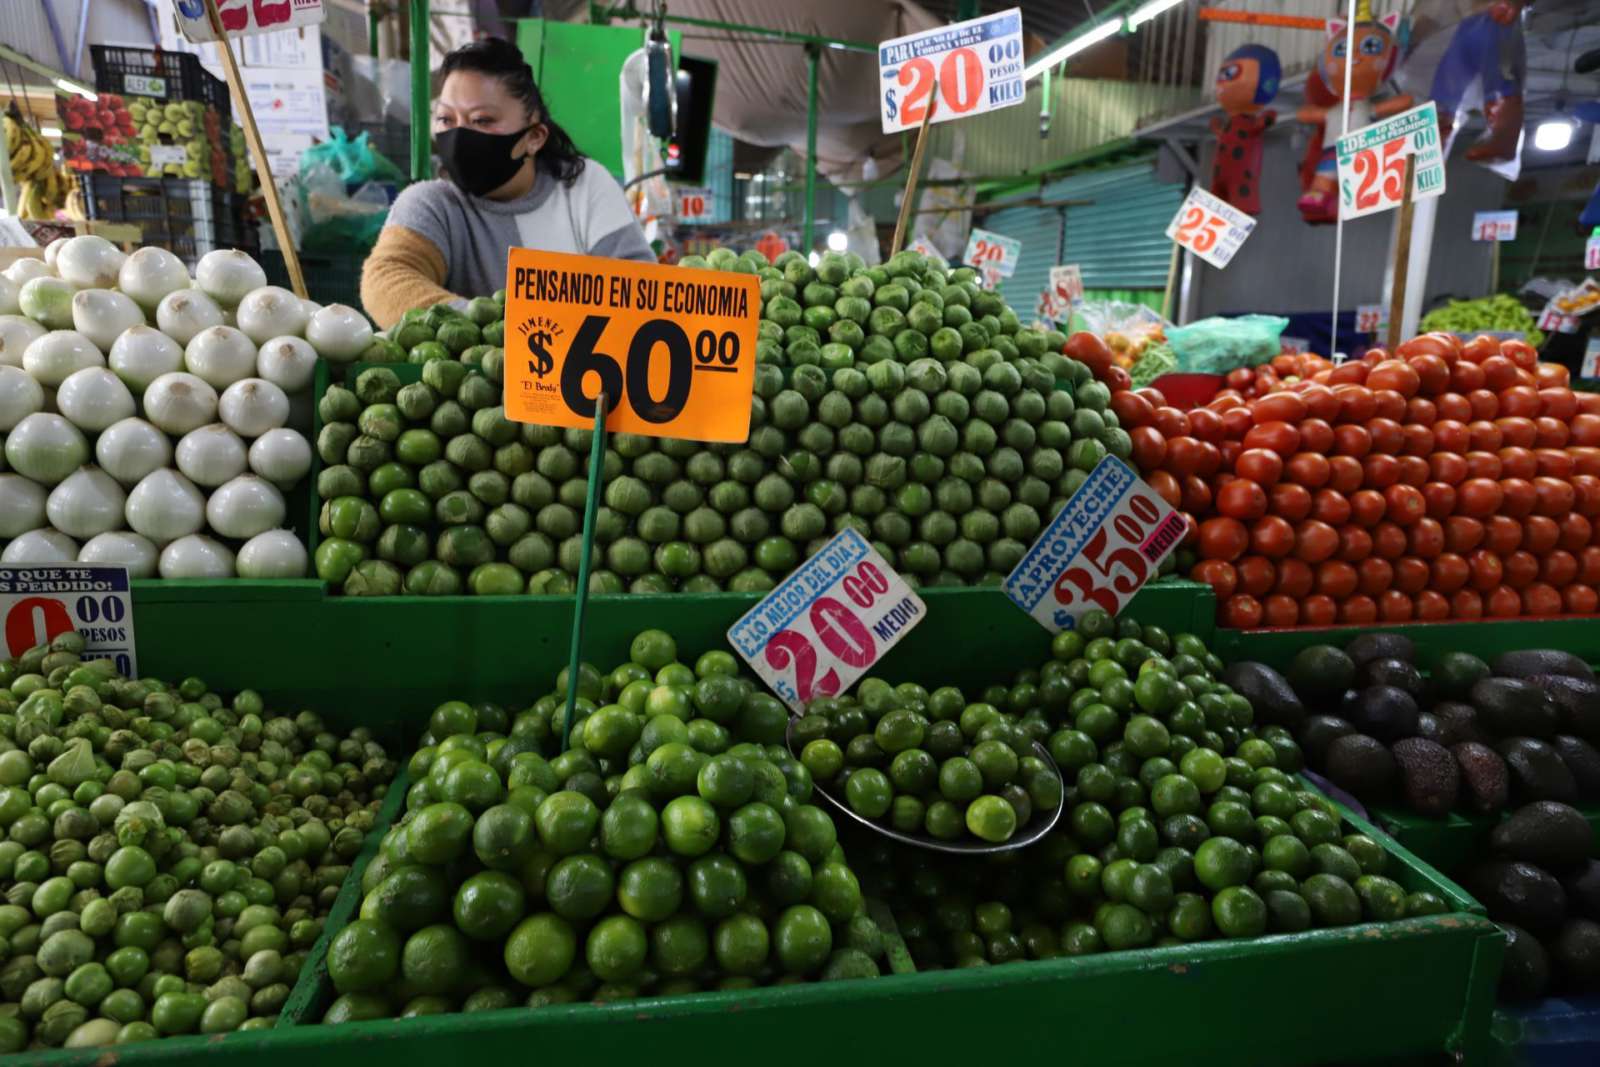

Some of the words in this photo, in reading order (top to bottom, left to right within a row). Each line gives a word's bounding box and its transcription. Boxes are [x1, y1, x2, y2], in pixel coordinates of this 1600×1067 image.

[887, 42, 915, 64] PARA
[990, 63, 1021, 79] PESOS
[885, 88, 897, 121] $
[898, 47, 984, 126] 20
[989, 39, 1020, 63] 00
[989, 80, 1022, 104] KILO
[1342, 179, 1352, 206] $
[1354, 137, 1406, 210] 25
[1414, 127, 1436, 150] 00
[1417, 166, 1442, 191] KILO
[682, 196, 704, 216] 10
[1175, 207, 1227, 252] 25
[515, 267, 604, 306] PENSANDO
[610, 276, 631, 309] EN
[636, 279, 658, 311] SU
[663, 281, 748, 319] ECONOMIA
[518, 316, 564, 336] JIMENEZ
[528, 330, 554, 379] $
[560, 315, 692, 424] 60
[695, 330, 740, 365] 00
[1019, 468, 1123, 600] APROVECHE
[1055, 525, 1148, 617] 35
[1114, 495, 1160, 544] 00
[1144, 515, 1184, 562] MEDIO
[16, 581, 112, 592] PERDIDO!
[18, 570, 62, 581] QUE
[66, 569, 92, 579] TE
[748, 619, 769, 641] LO
[766, 585, 805, 625] MEJOR
[804, 566, 832, 591] DEL
[826, 546, 853, 570] DIA
[76, 595, 125, 623] 00
[873, 597, 919, 642] MEDIO
[79, 627, 126, 642] PESOS
[765, 597, 876, 703] 20
[843, 561, 888, 608] 00
